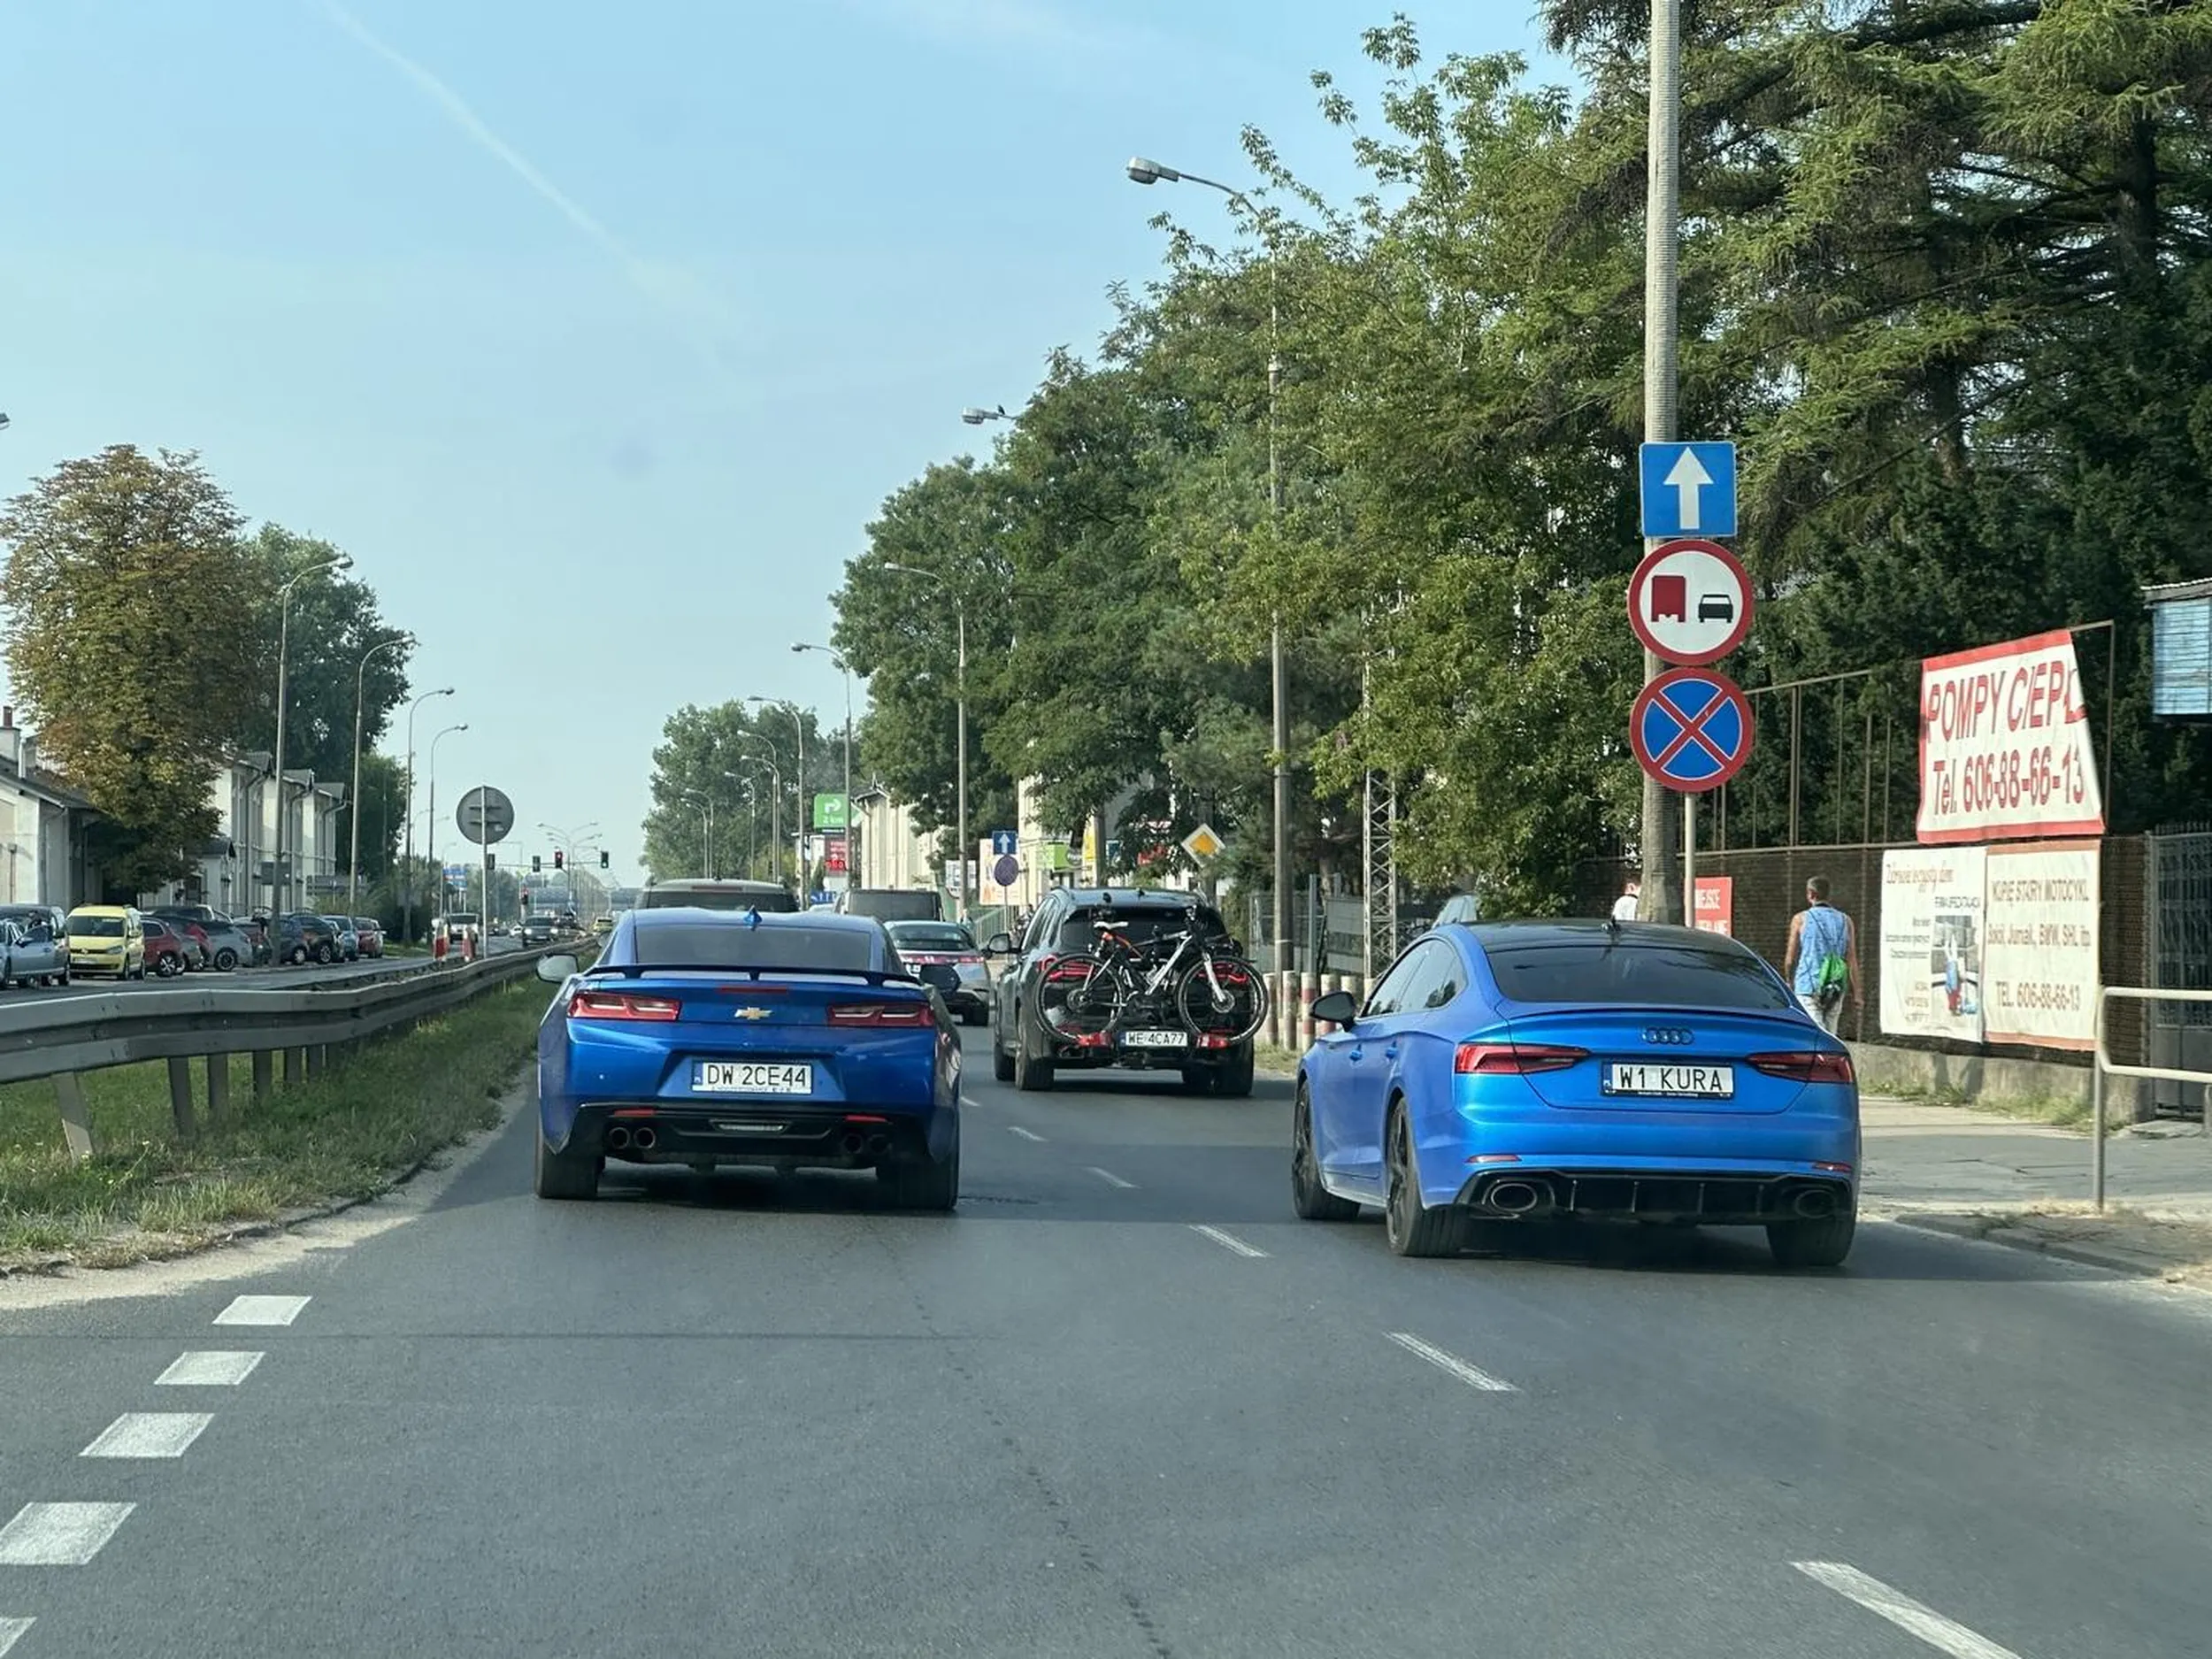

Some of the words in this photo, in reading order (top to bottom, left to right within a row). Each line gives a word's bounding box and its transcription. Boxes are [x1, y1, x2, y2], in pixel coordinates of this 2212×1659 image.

[1924, 670, 2007, 744] POMPY
[1963, 743, 2085, 813] 606-88-66-13
[2017, 982, 2080, 1011] 606-88-66-13
[1128, 1033, 1144, 1045] WE
[1148, 1033, 1185, 1045] 4CA77
[708, 1064, 733, 1085] DW
[741, 1065, 806, 1087] 2CE44
[1620, 1066, 1646, 1088] W1
[1660, 1067, 1723, 1092] KURA
